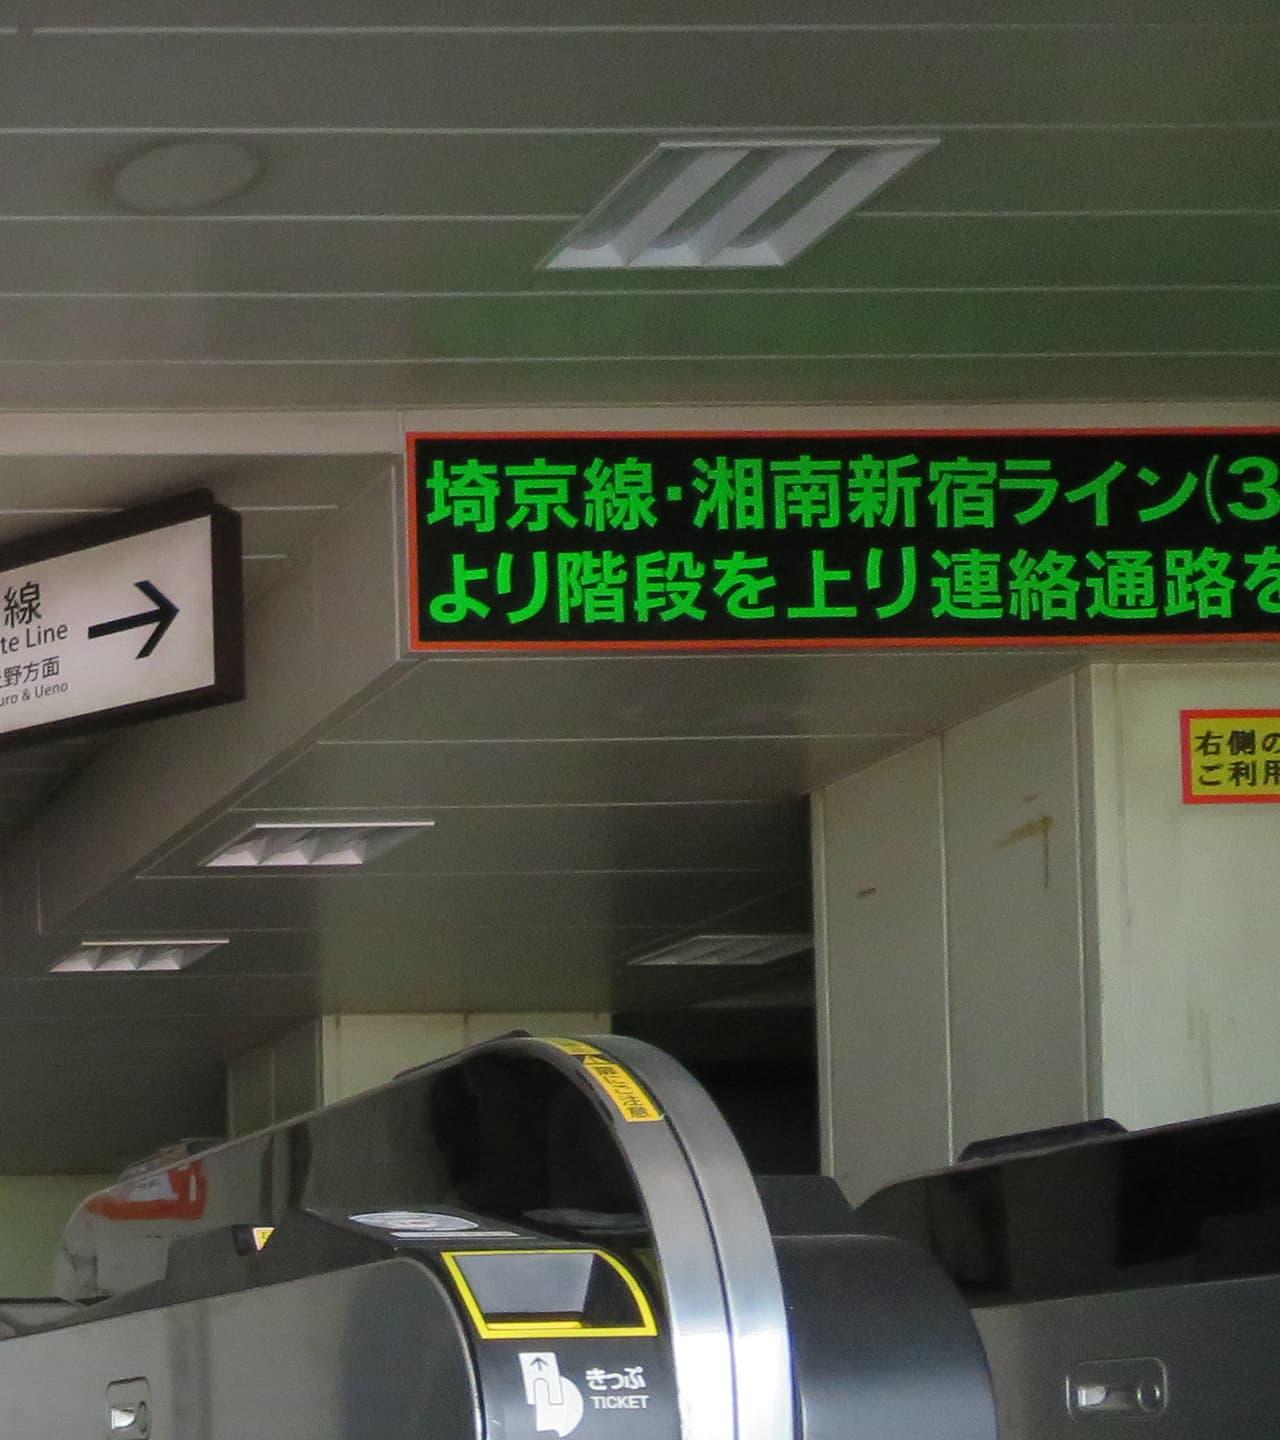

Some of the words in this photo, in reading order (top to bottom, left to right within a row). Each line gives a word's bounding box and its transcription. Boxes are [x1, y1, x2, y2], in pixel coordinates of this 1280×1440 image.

[26, 622, 69, 650] Line
[21, 688, 31, 701] &
[34, 680, 69, 699] Ueno
[585, 1366, 647, 1391] きっぷ
[589, 1394, 649, 1410] TICKET
